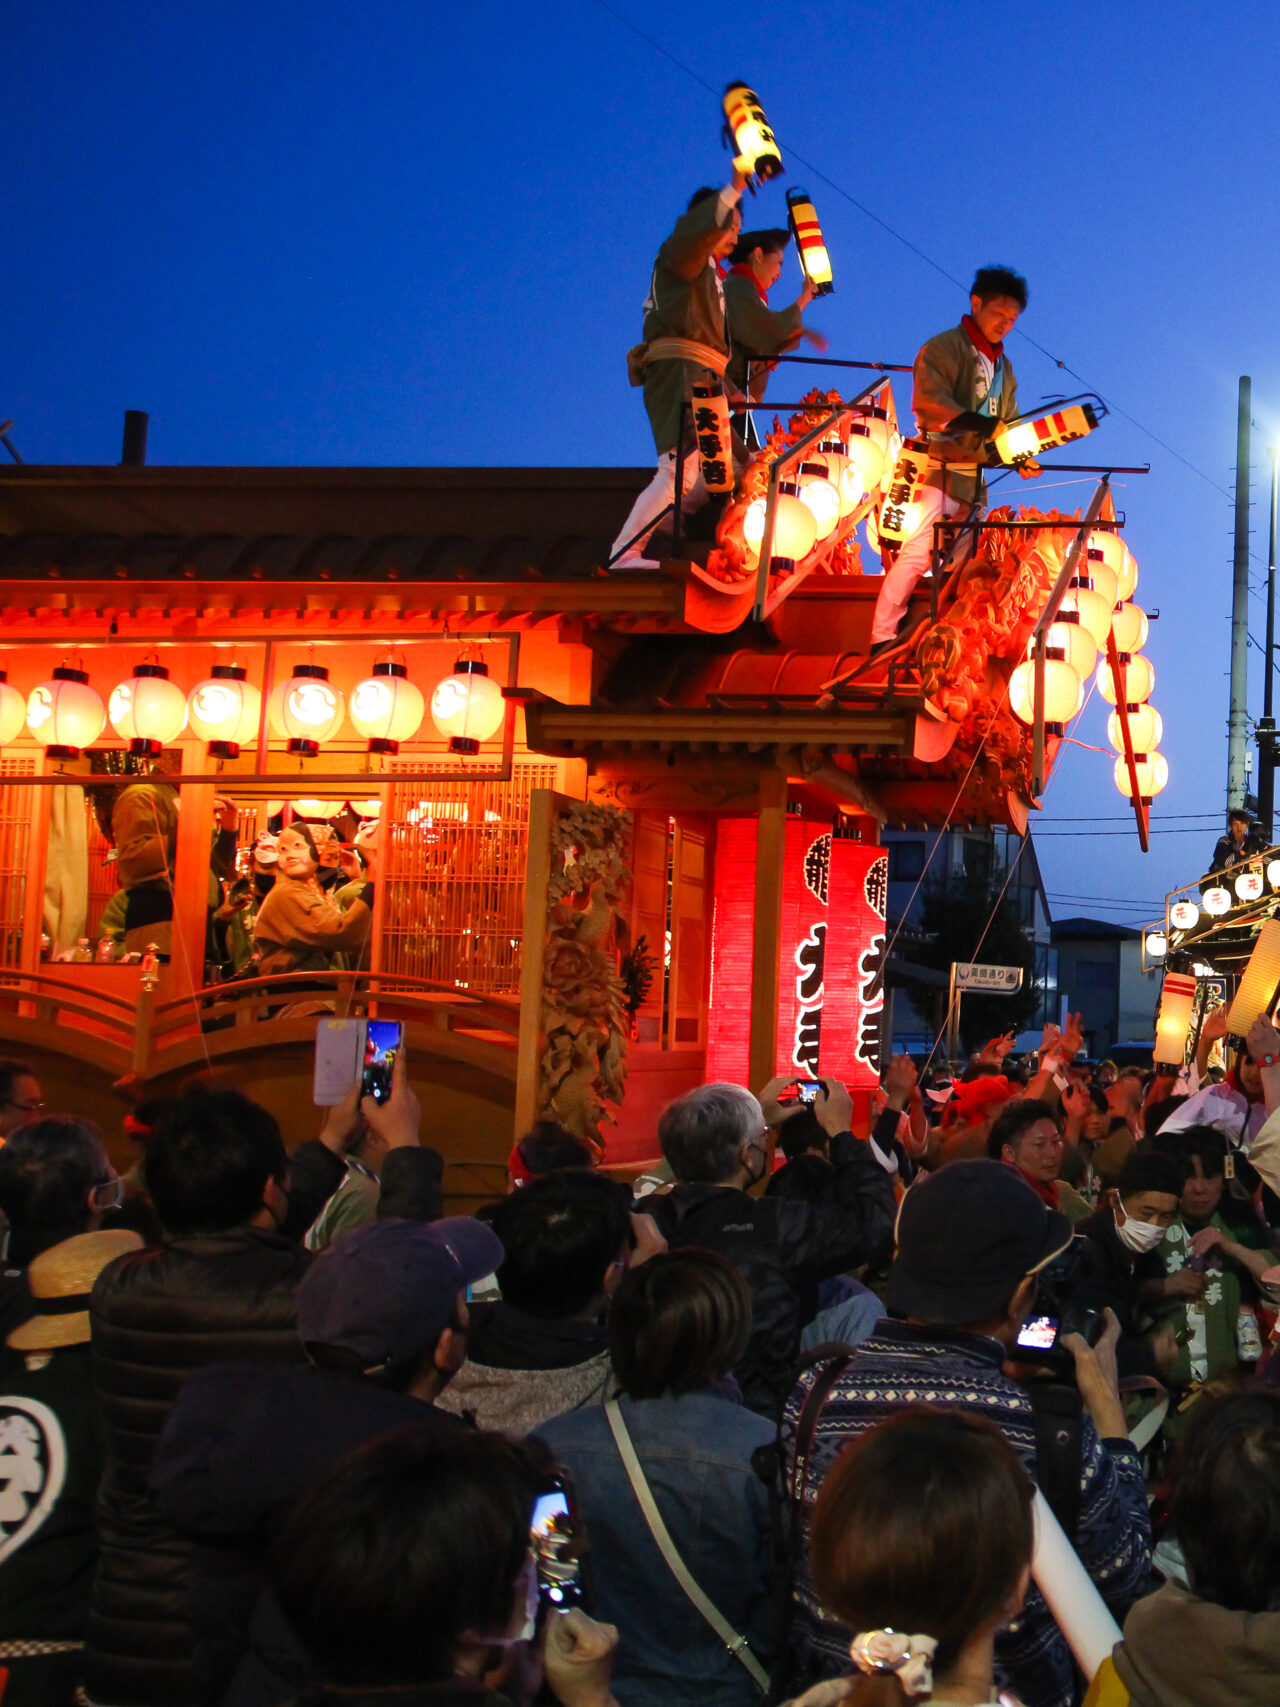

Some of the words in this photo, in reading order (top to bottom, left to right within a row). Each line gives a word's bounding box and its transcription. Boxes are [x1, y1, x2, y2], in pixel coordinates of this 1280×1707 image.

[1247, 879, 1259, 891] 元
[1211, 893, 1223, 905] 元
[1175, 907, 1187, 919] 元
